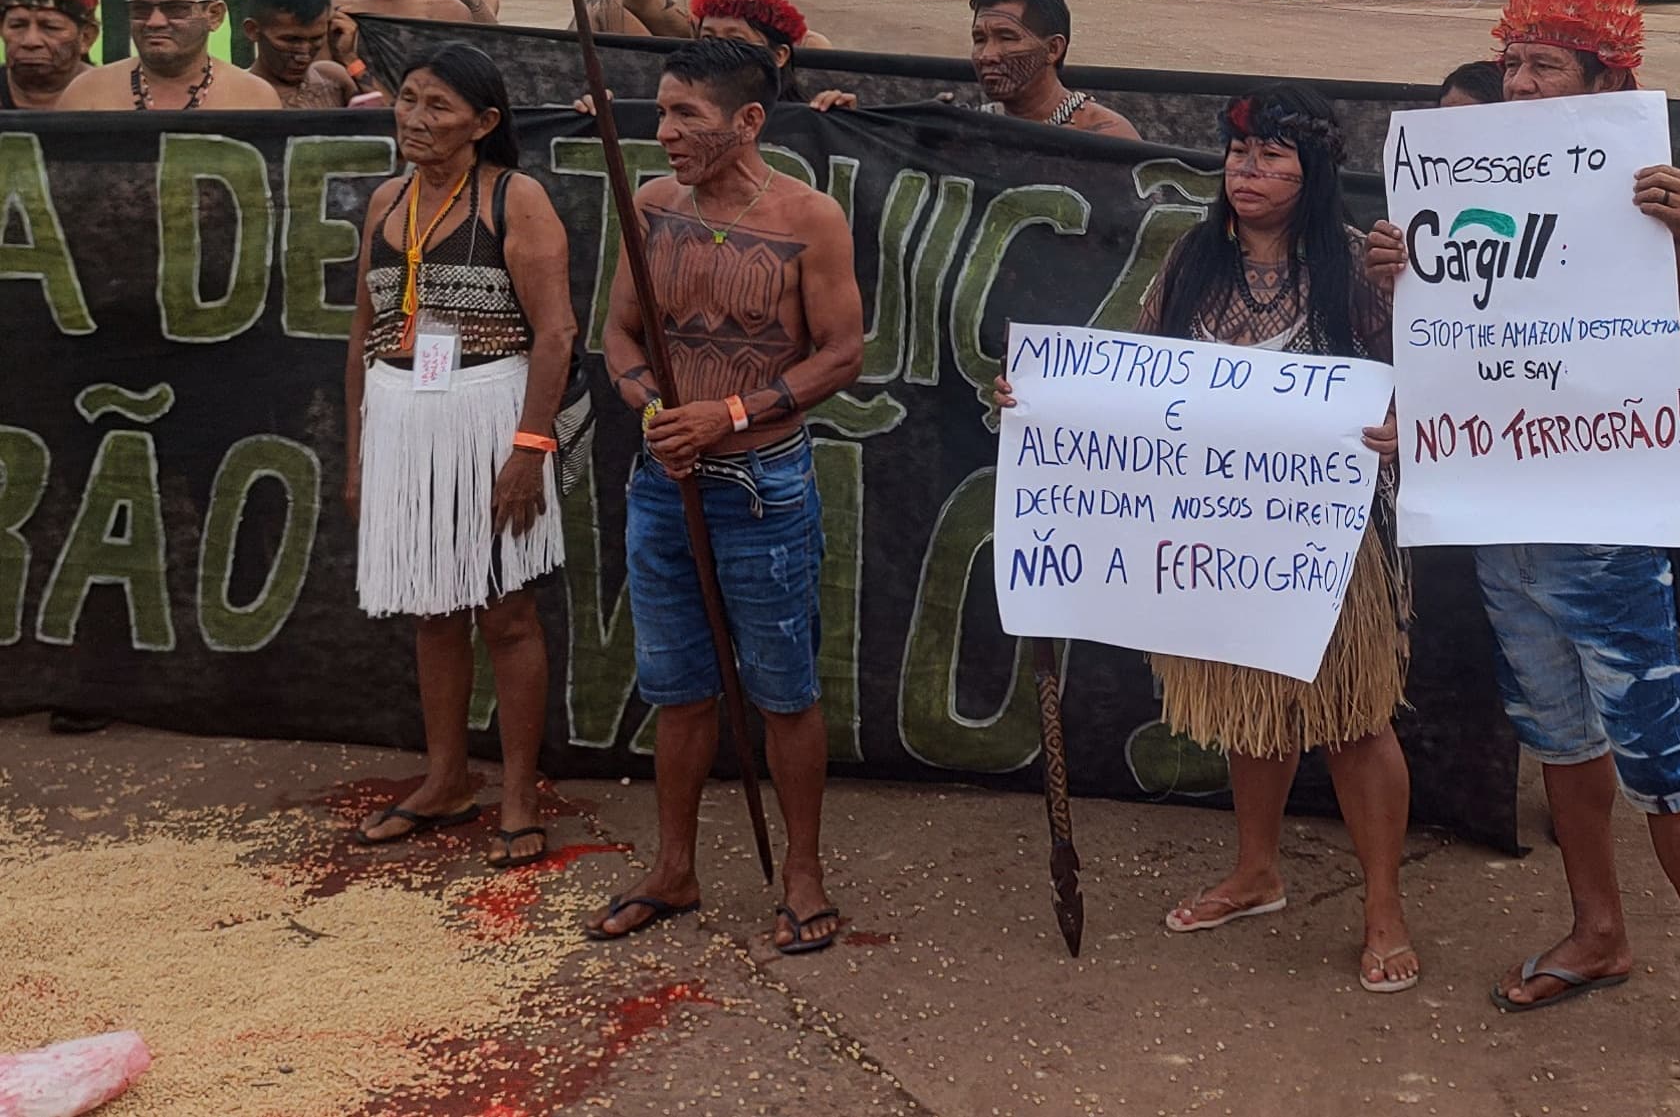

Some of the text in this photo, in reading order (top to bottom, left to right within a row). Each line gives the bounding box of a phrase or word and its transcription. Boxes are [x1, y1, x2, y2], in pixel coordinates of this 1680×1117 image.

[1501, 317, 1574, 349] AMAZON
[1209, 357, 1253, 390] DO
[1273, 364, 1352, 402] STF
[1478, 360, 1515, 382] WE
[1165, 399, 1187, 431] E
[1017, 426, 1189, 477] ALEXANDRE
[1205, 447, 1236, 479] DE
[1415, 413, 1456, 463] NO
[1459, 415, 1493, 457] TO
[1015, 484, 1155, 523] DEFENDAM
[1171, 495, 1254, 521] NOSSOS
[1105, 546, 1128, 585] A
